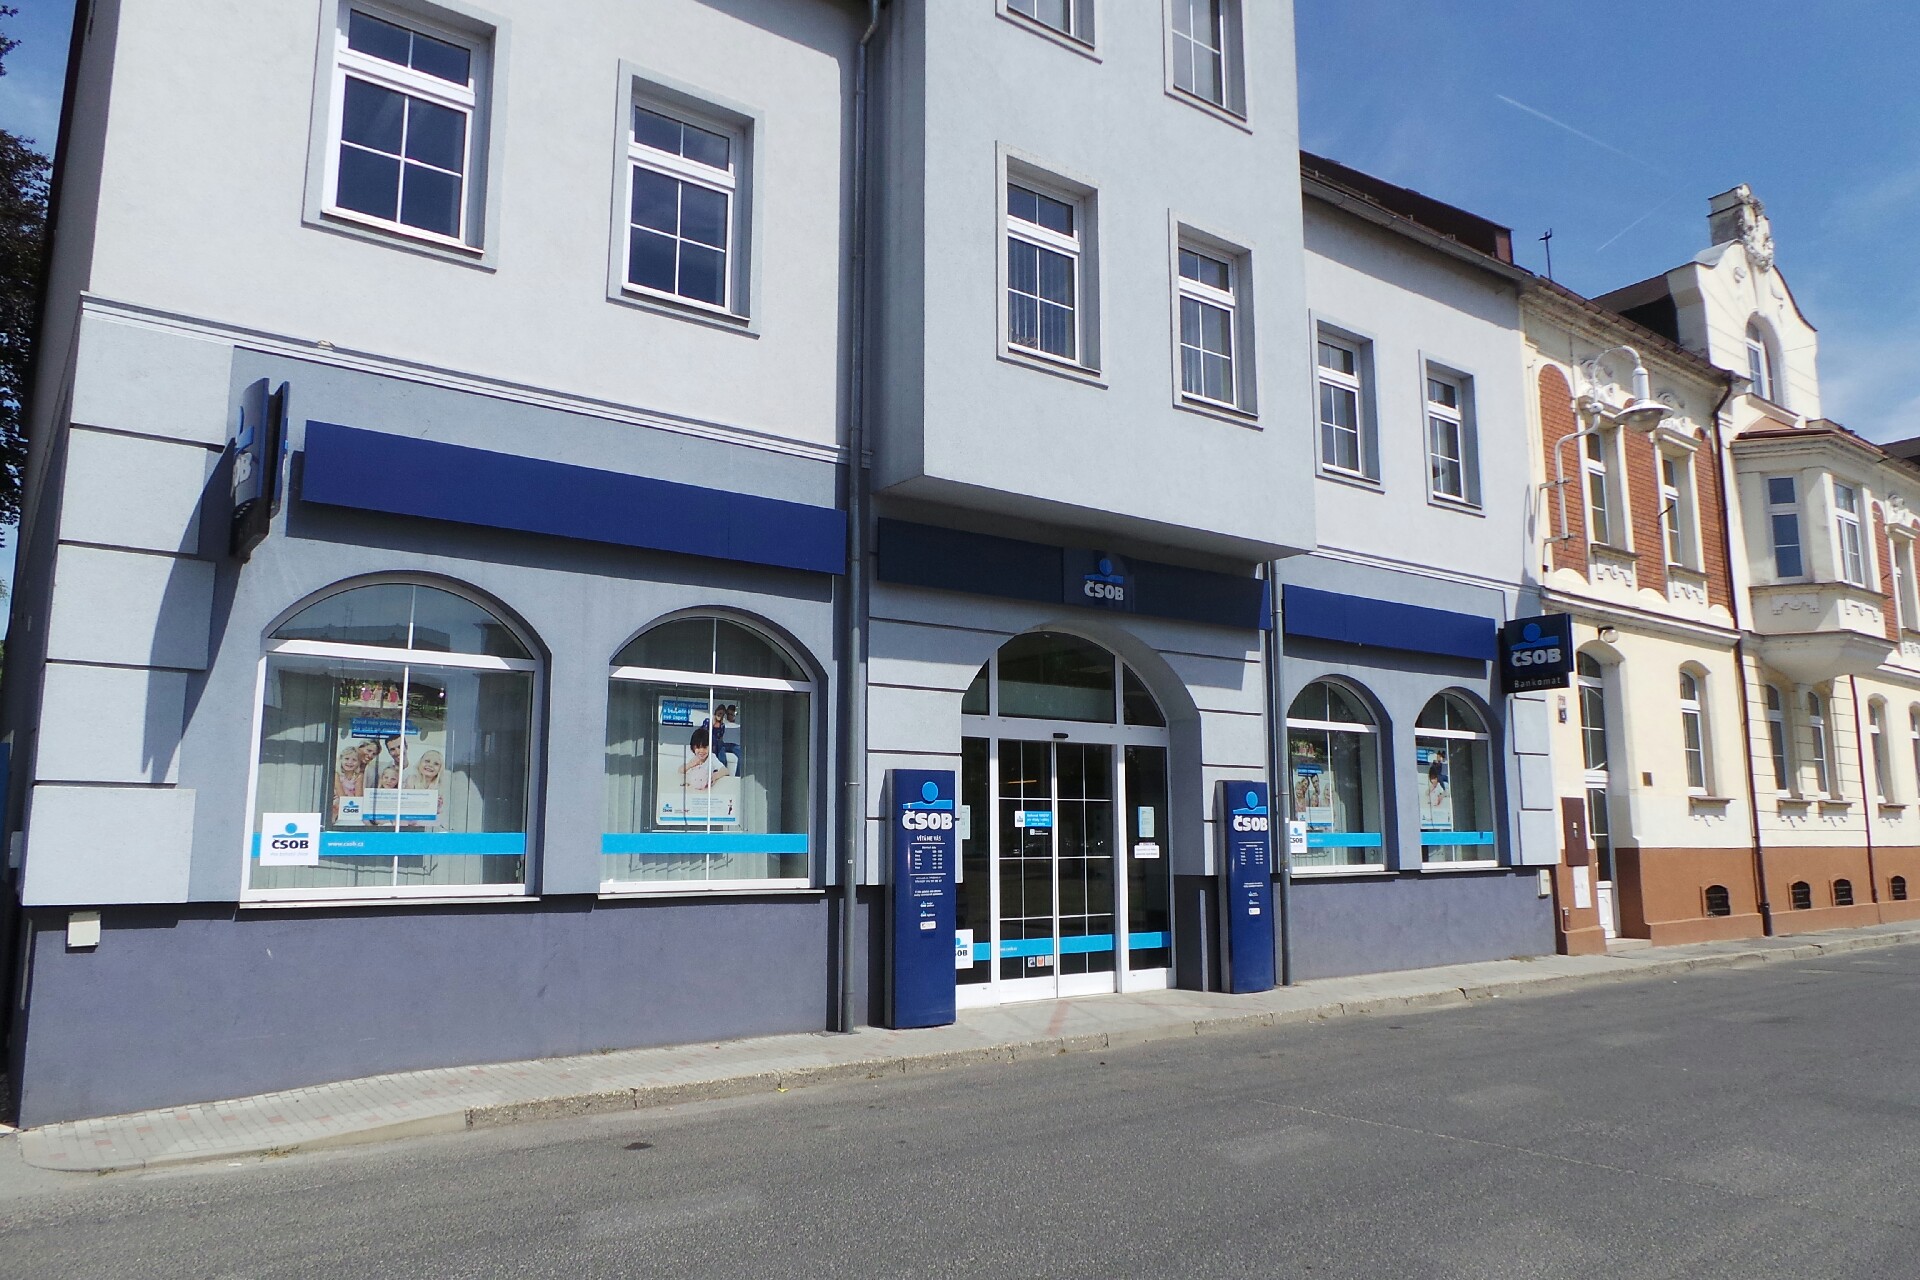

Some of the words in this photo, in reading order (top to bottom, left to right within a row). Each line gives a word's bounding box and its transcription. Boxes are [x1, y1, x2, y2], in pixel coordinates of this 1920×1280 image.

[1083, 580, 1124, 600] ČSOB
[1511, 648, 1561, 667] ČSOB
[1514, 677, 1561, 688] Bankomat
[902, 810, 953, 830] ČSOB
[1233, 815, 1268, 831] ČSOB
[271, 839, 309, 849] ČSOB
